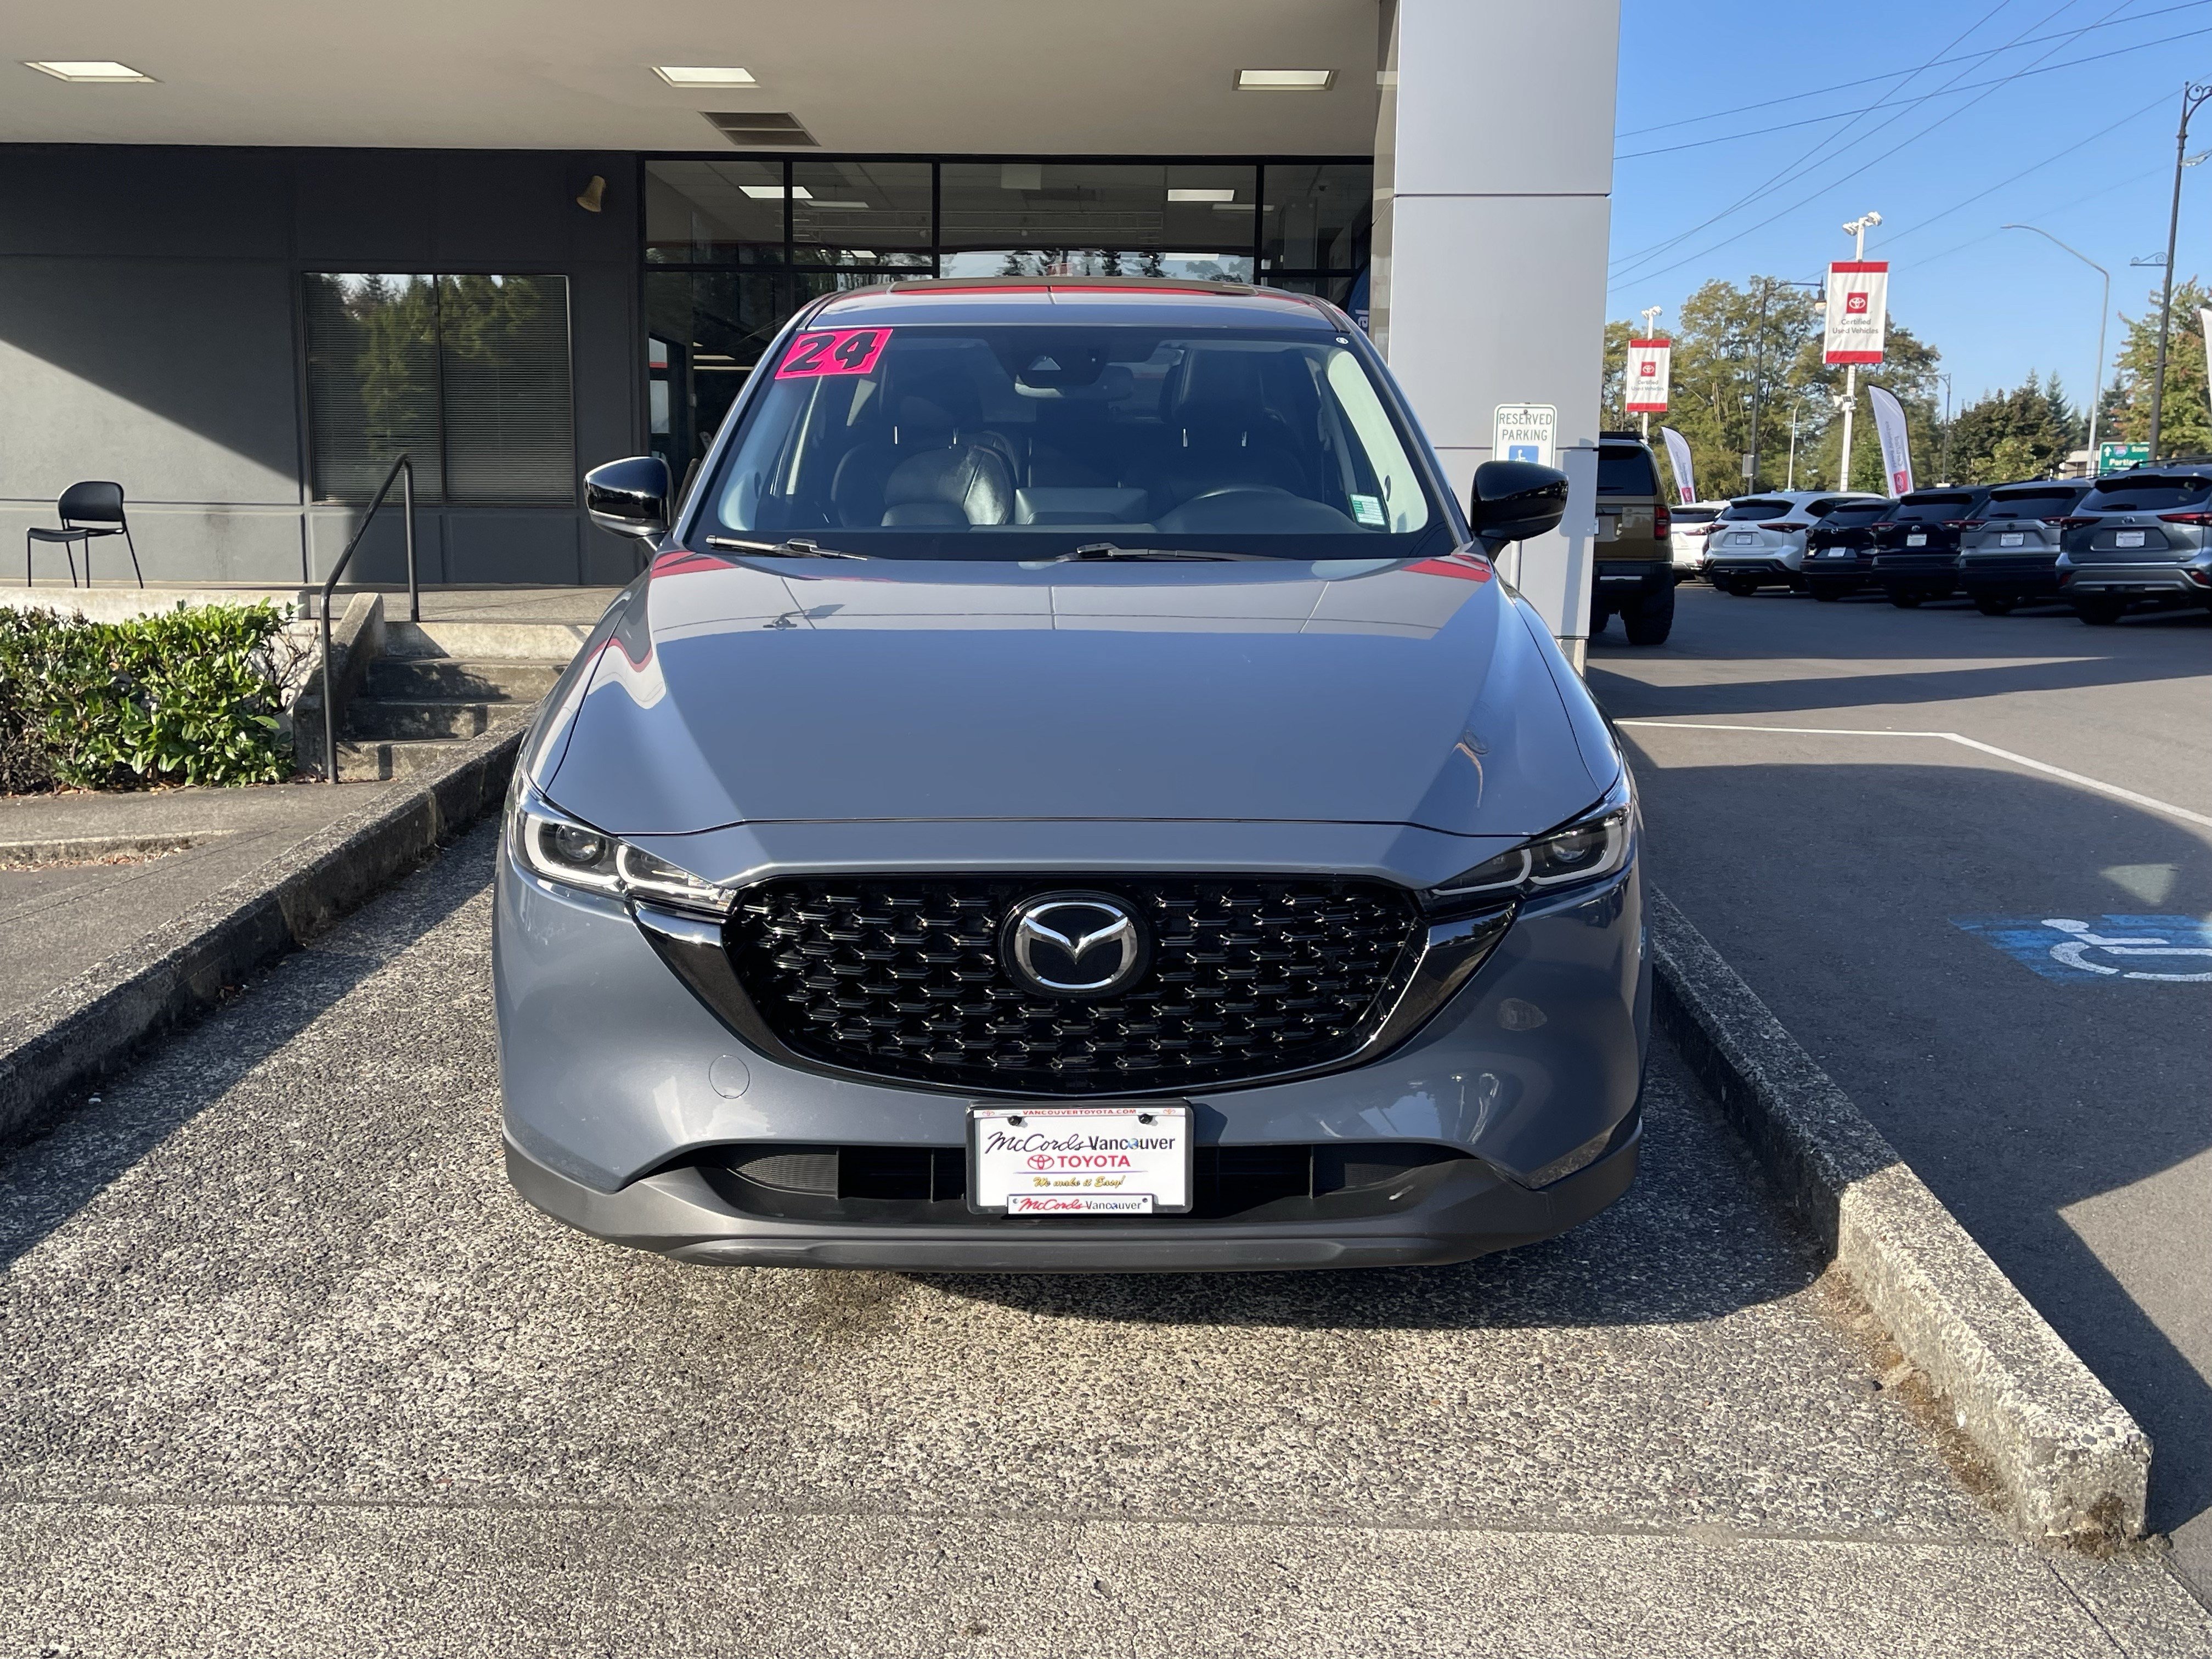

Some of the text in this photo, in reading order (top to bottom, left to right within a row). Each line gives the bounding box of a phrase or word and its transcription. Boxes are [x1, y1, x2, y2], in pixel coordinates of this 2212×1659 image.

[783, 331, 878, 373] 24
[1499, 413, 1552, 425] RESERVED
[1502, 429, 1548, 441] PARKING
[1057, 1155, 1131, 1168] TOYOTA
[1033, 1177, 1051, 1187] We
[1053, 1177, 1080, 1187] make
[1094, 1175, 1126, 1189] Easy!
